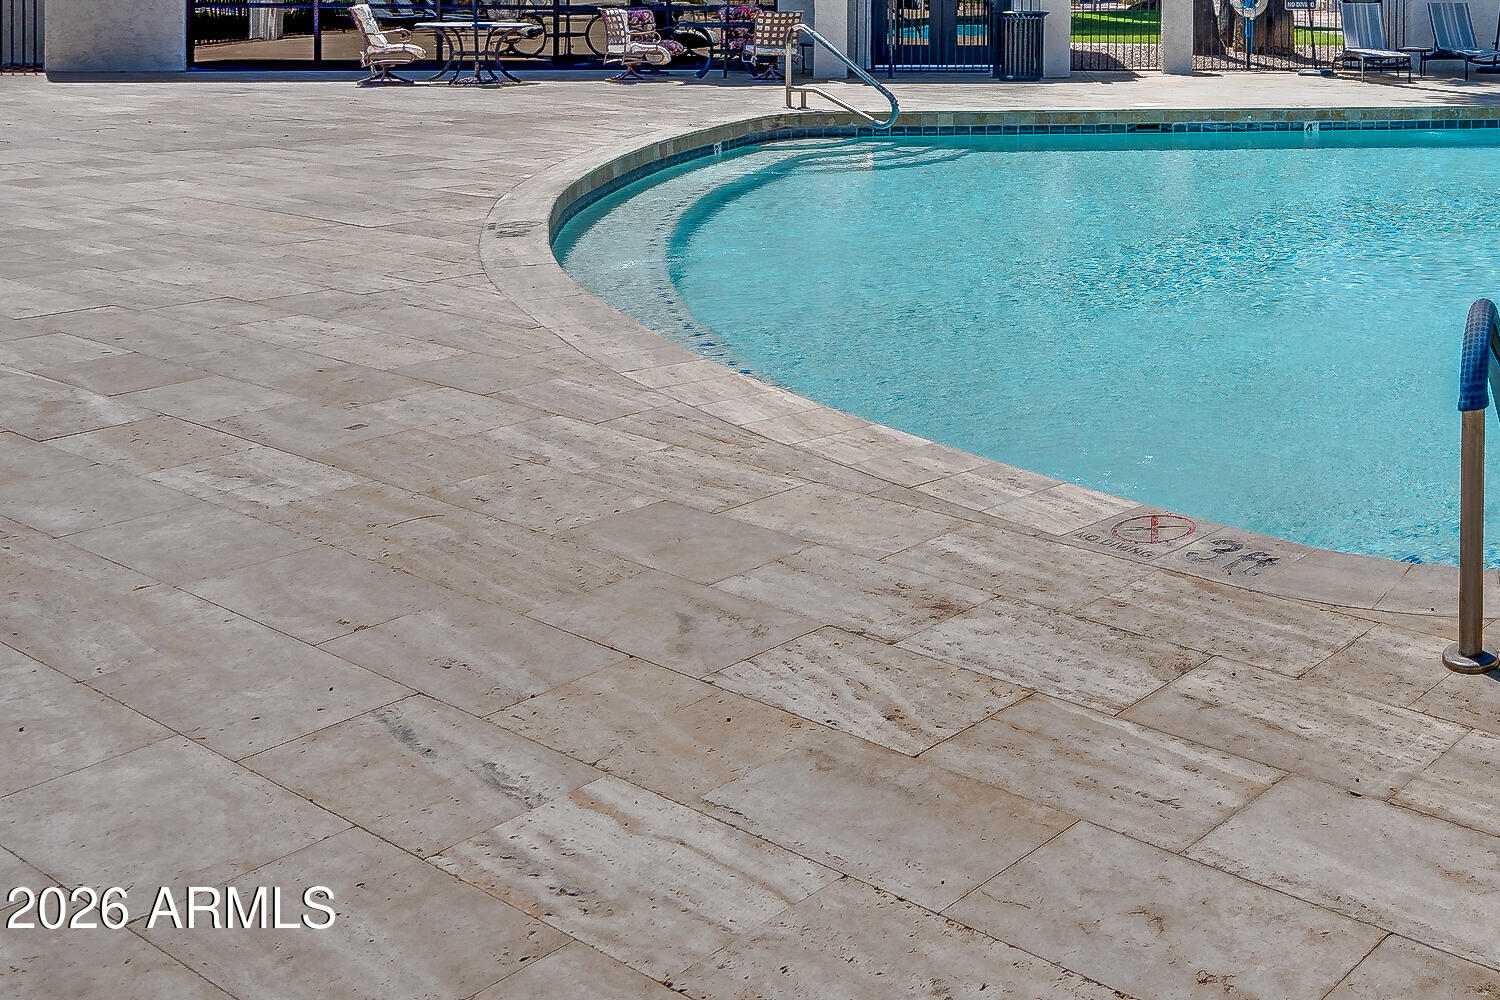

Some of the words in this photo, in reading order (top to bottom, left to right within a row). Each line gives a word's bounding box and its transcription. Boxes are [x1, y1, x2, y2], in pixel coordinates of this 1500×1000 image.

[1073, 531, 1100, 541] NO
[1099, 538, 1154, 559] DIVING
[1185, 539, 1244, 563] 3
